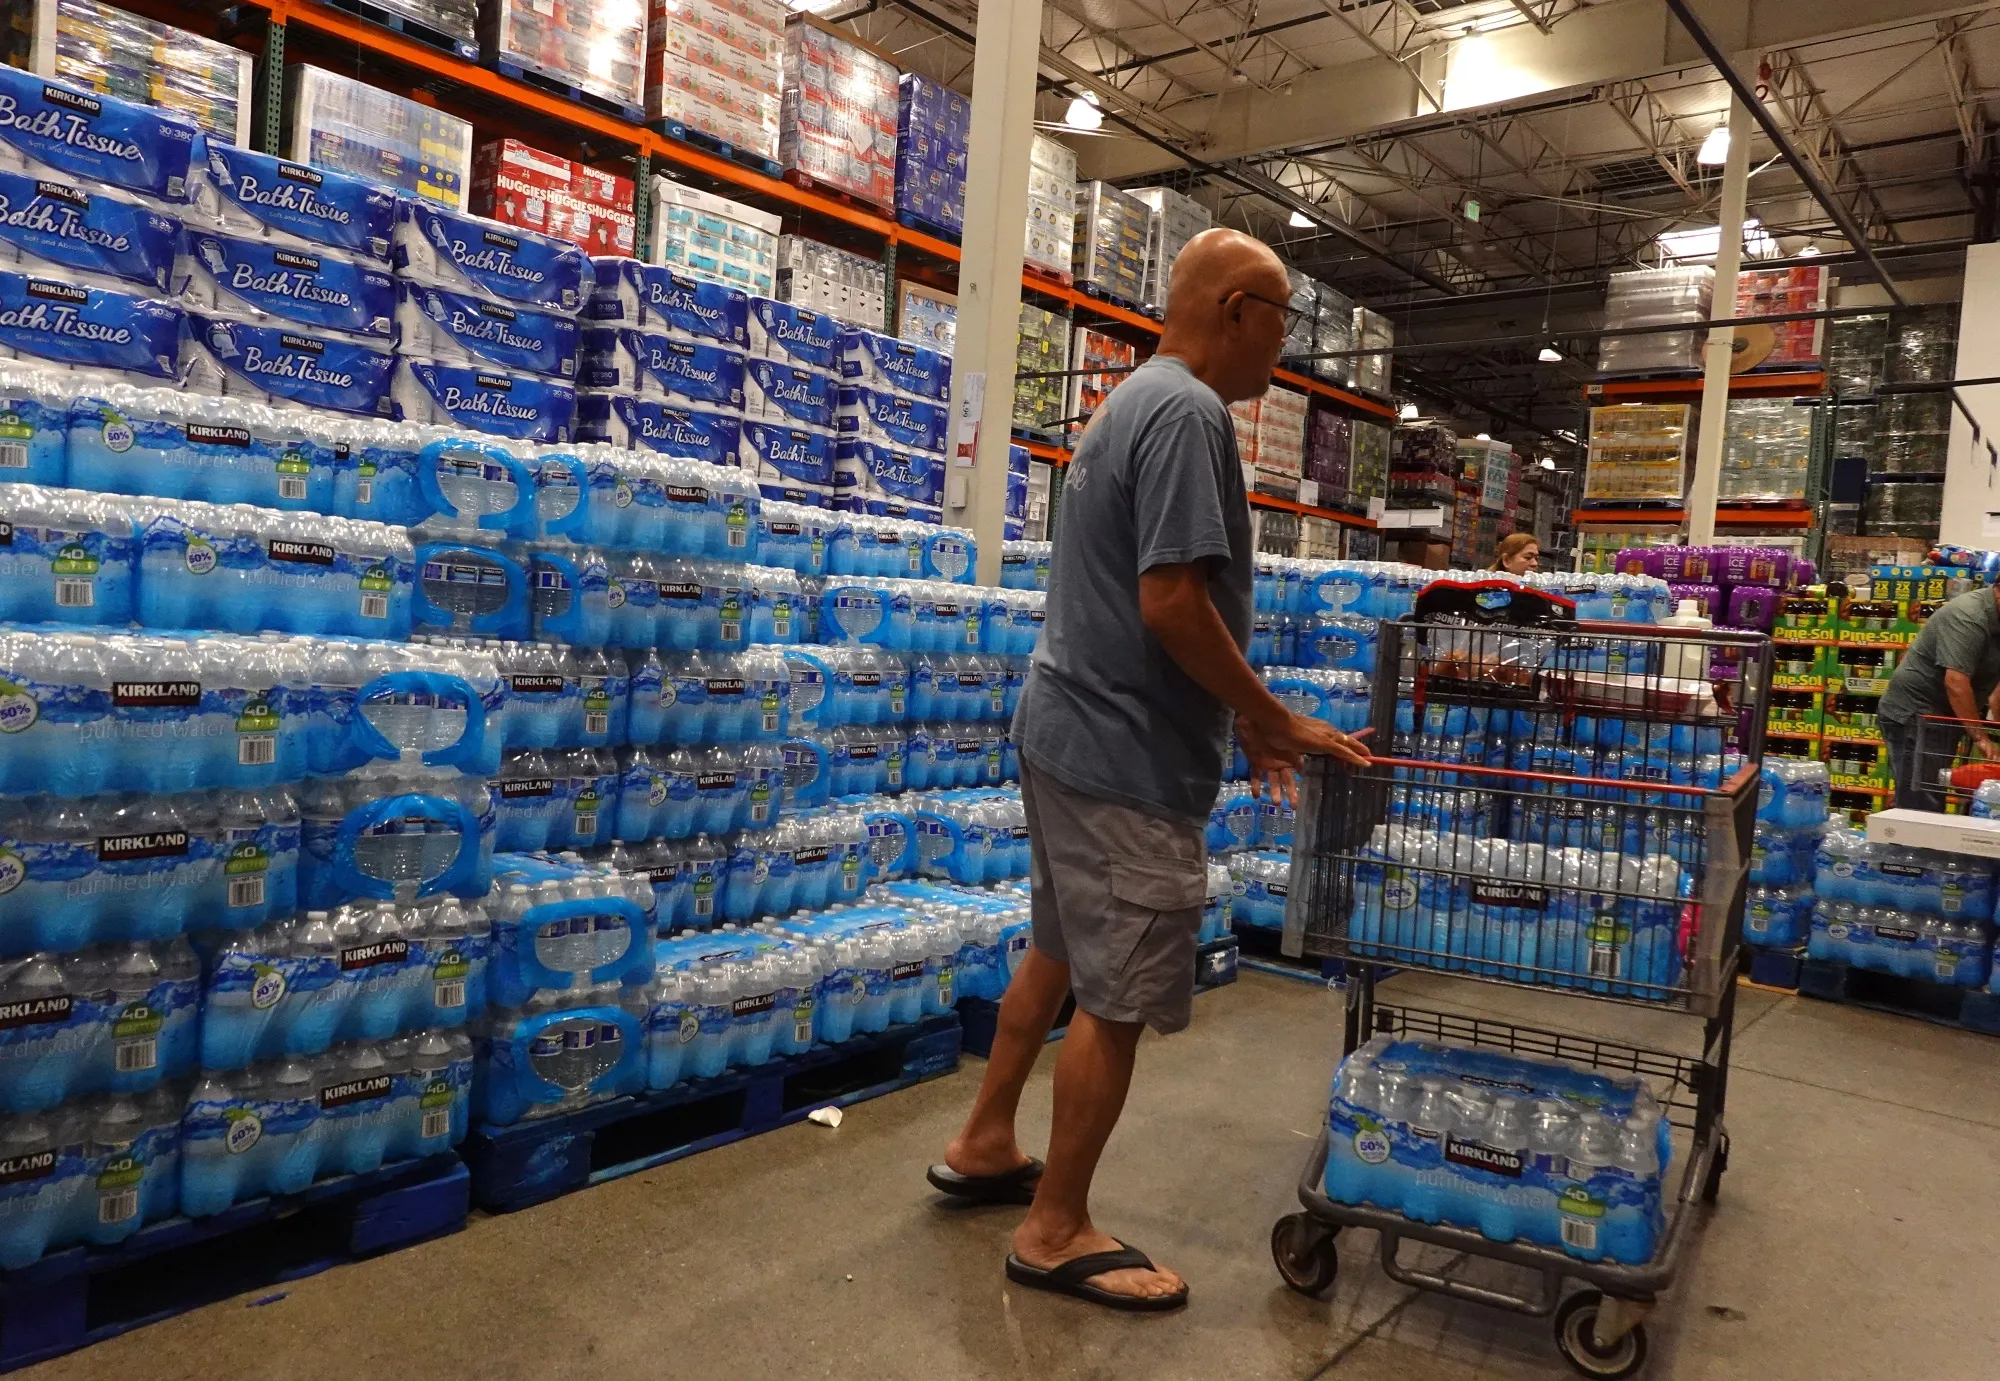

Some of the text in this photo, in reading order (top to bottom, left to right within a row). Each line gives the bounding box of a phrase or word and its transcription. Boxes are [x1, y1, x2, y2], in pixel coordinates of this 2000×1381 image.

[45, 87, 100, 111] KIRKLAND
[0, 95, 141, 160] Bath Tissue
[159, 125, 171, 135] 30
[280, 165, 322, 183] KIRKLAND
[583, 166, 616, 184] HUGGIES
[497, 174, 547, 201] HUGGIES
[563, 182, 569, 192] 6
[238, 175, 350, 225] Bath Tissue
[546, 189, 595, 217] HUGGIES
[627, 203, 633, 212] 6
[592, 204, 636, 228] HUGGIES
[59, 207, 130, 251] Tissue
[485, 232, 518, 248] KIRKLAND
[276, 252, 319, 268] KIRKLAND
[452, 239, 544, 283] Bath Tissue
[30, 283, 87, 299] KIRKLAND
[232, 263, 351, 307] Bath Tissue
[651, 283, 682, 308] Bath
[0, 304, 132, 344] ath Tissue
[451, 311, 542, 351] Bath Tissue
[777, 319, 832, 350] Bath Tissue
[283, 335, 323, 350] KIRKLAND
[244, 346, 353, 388] Bath Tissue
[681, 360, 717, 382] Tissue
[478, 376, 511, 388] KIRKLAND
[774, 380, 803, 401] Bath
[445, 388, 538, 420] Bath Tissue
[901, 412, 928, 432] Tissue
[107, 431, 129, 441] 50%
[190, 425, 249, 441] KIRKLAND
[642, 418, 710, 446] Bath Tissue
[283, 453, 300, 462] 40
[770, 441, 800, 461] Bath
[60, 549, 84, 559] 40
[272, 542, 333, 557] KIRKLAND
[188, 552, 211, 564] 50%
[1664, 558, 1680, 567] ICE
[1729, 559, 1746, 568] ICE
[367, 569, 384, 578] 40
[1874, 582, 1888, 590] 2X
[1896, 582, 1911, 590] 2X
[1930, 579, 1944, 588] 2X
[1774, 627, 1834, 640] Pine-Sol
[1840, 629, 1904, 643] Pine-Sol
[515, 677, 562, 687] KIRKLAND
[1773, 674, 1823, 686] ine-Sol
[117, 684, 199, 698] KIRKLAND
[244, 705, 268, 716] 40
[80, 721, 163, 743] purified
[172, 721, 225, 738] water
[1767, 721, 1819, 733] ine-Sol
[1825, 724, 1883, 739] Pine-So
[504, 780, 551, 793] KIRKLAND
[755, 783, 768, 791] 40
[1830, 774, 1883, 789] ine-Sol
[579, 791, 595, 799] 40
[103, 834, 186, 852] KIRKLAND
[233, 847, 256, 858] 40
[846, 854, 858, 862] 40
[67, 874, 149, 900] purified
[1386, 887, 1411, 898] 50%
[345, 942, 406, 963] KIRKLAND
[440, 954, 459, 964] 40
[256, 979, 281, 998] 50%
[0, 998, 69, 1018] RKLAND
[121, 1007, 148, 1019] 40
[325, 1077, 389, 1100] KIRKLAND
[427, 1083, 446, 1094] 40
[231, 1122, 257, 1144] 50%
[1360, 1141, 1386, 1151] 50%
[1449, 1143, 1520, 1169] KIRKLAND
[106, 1158, 132, 1172] 40
[1415, 1168, 1489, 1196] purified
[1564, 1187, 1589, 1201] 40
